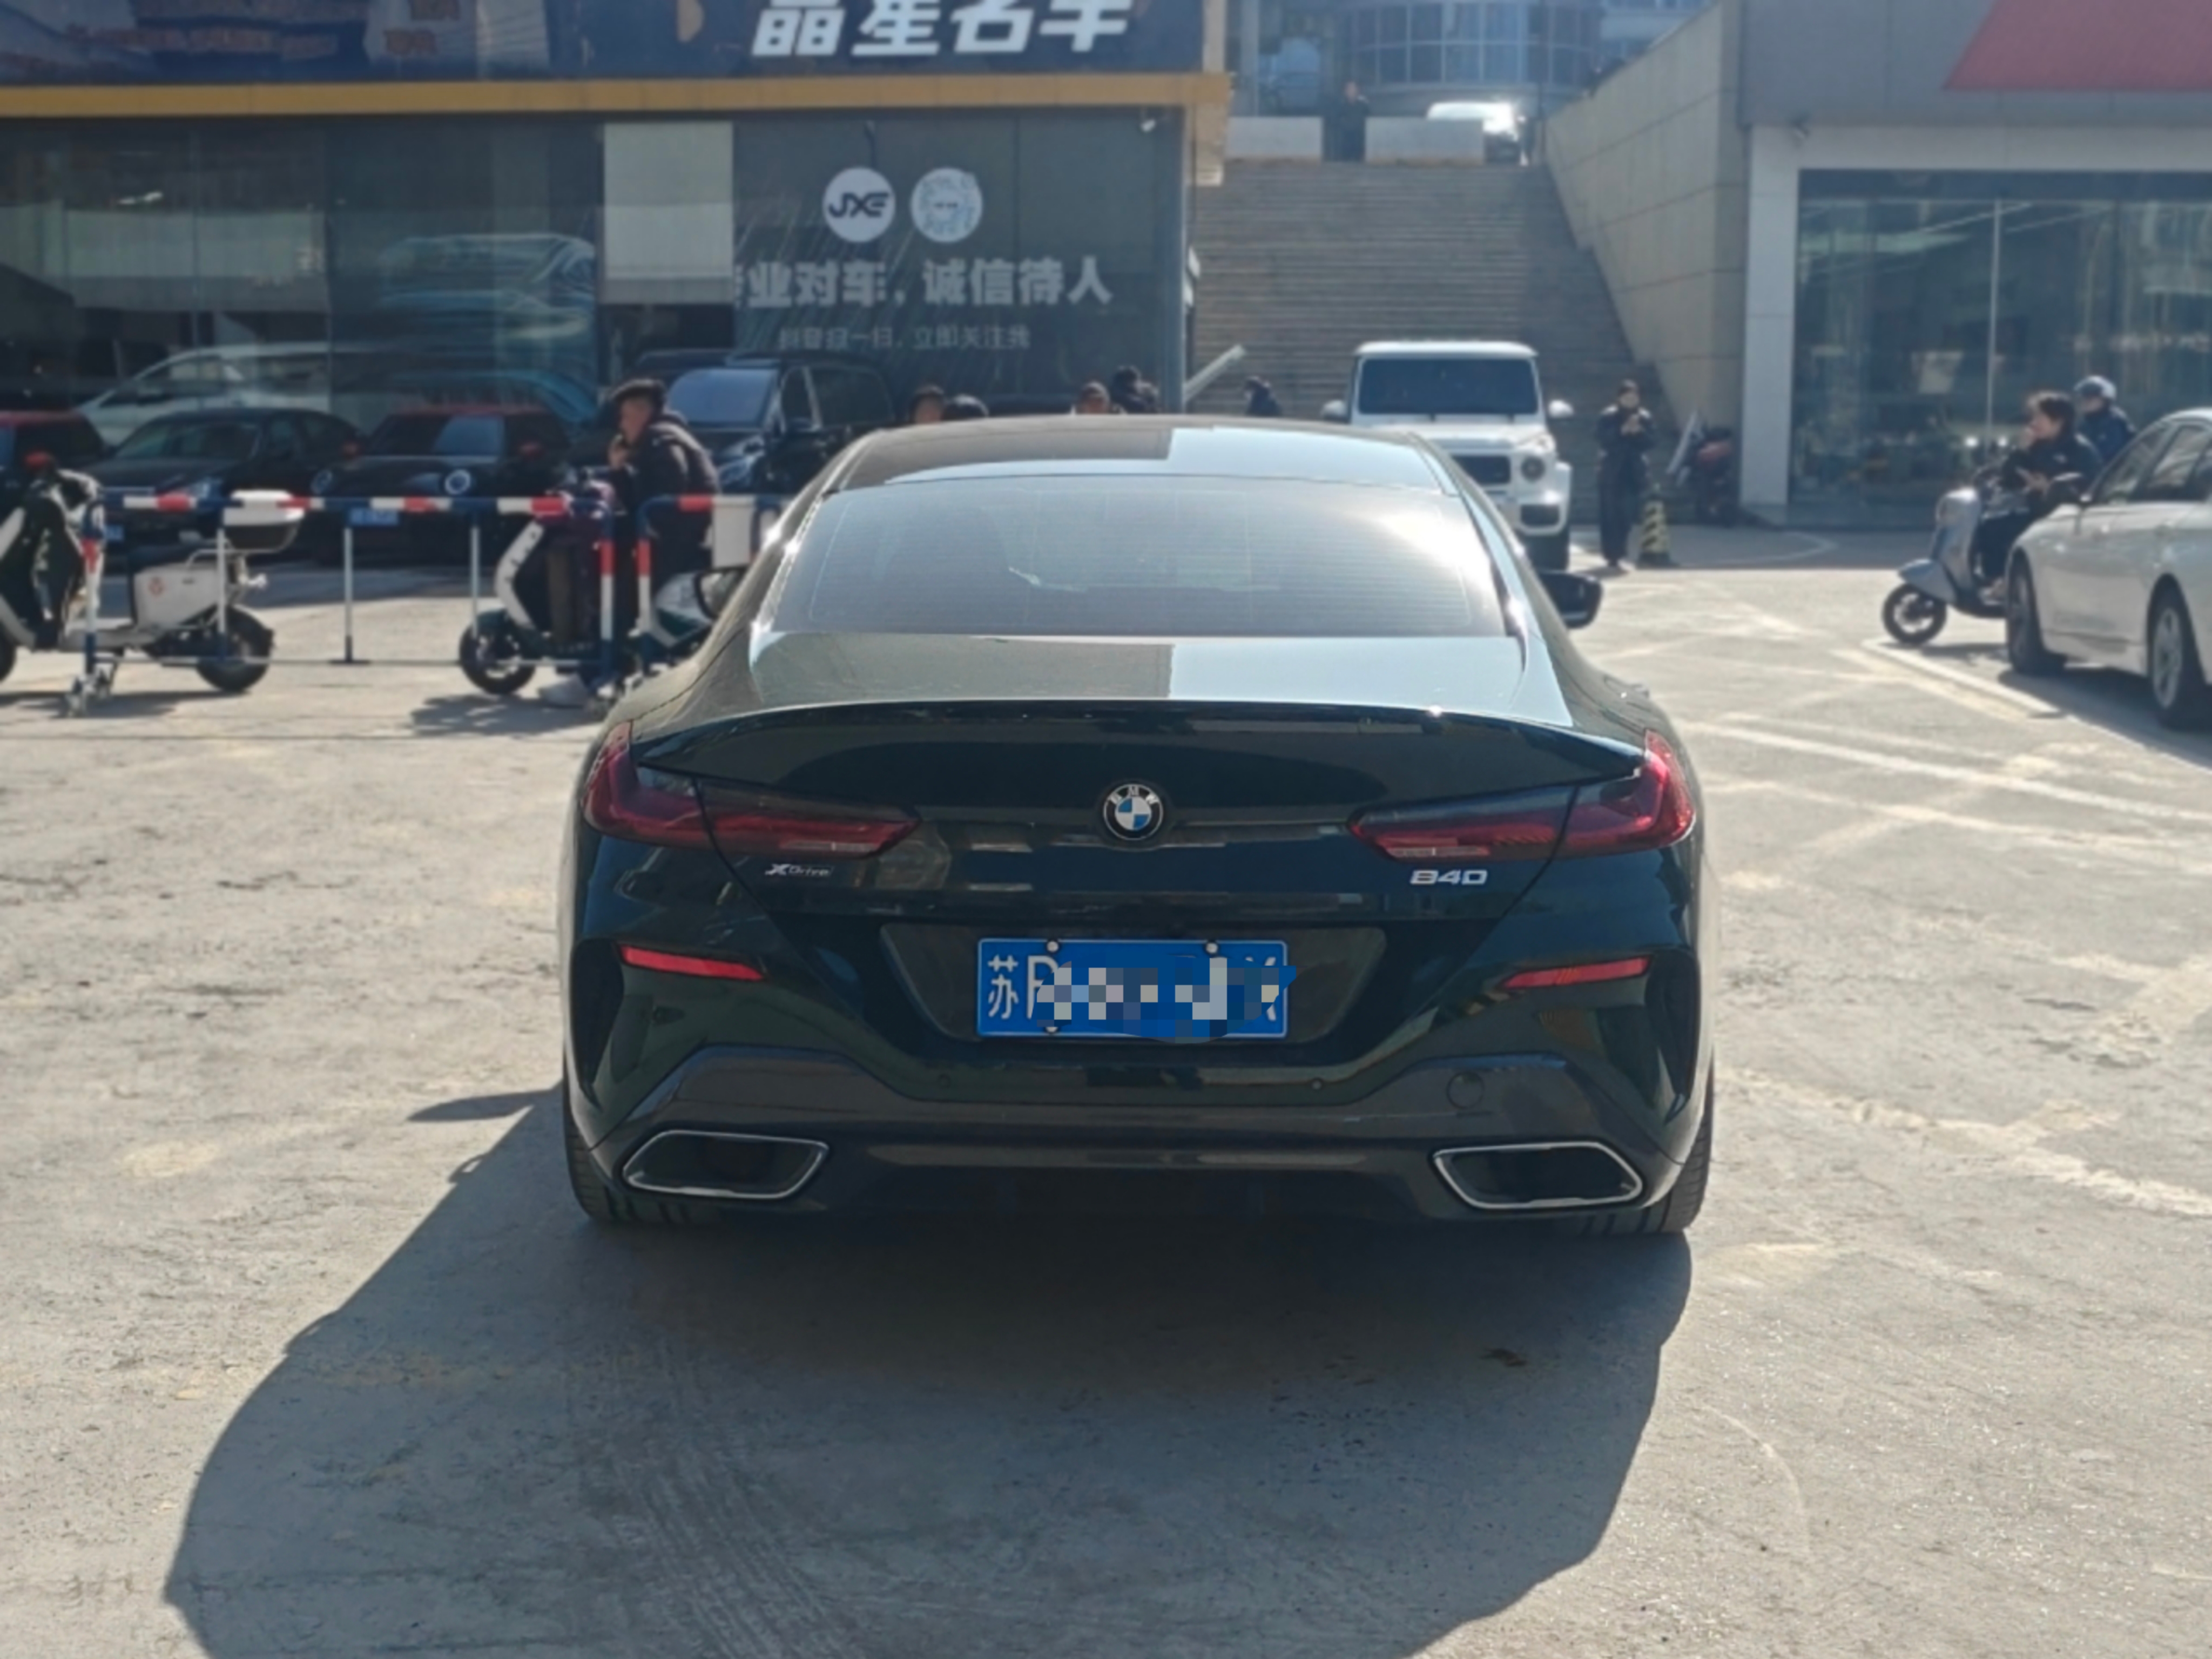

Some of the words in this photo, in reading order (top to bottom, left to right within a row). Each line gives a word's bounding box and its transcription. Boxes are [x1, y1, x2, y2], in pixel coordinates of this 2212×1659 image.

[734, 255, 1114, 309] 业对车，诚信待人
[1410, 869, 1488, 885] 840
